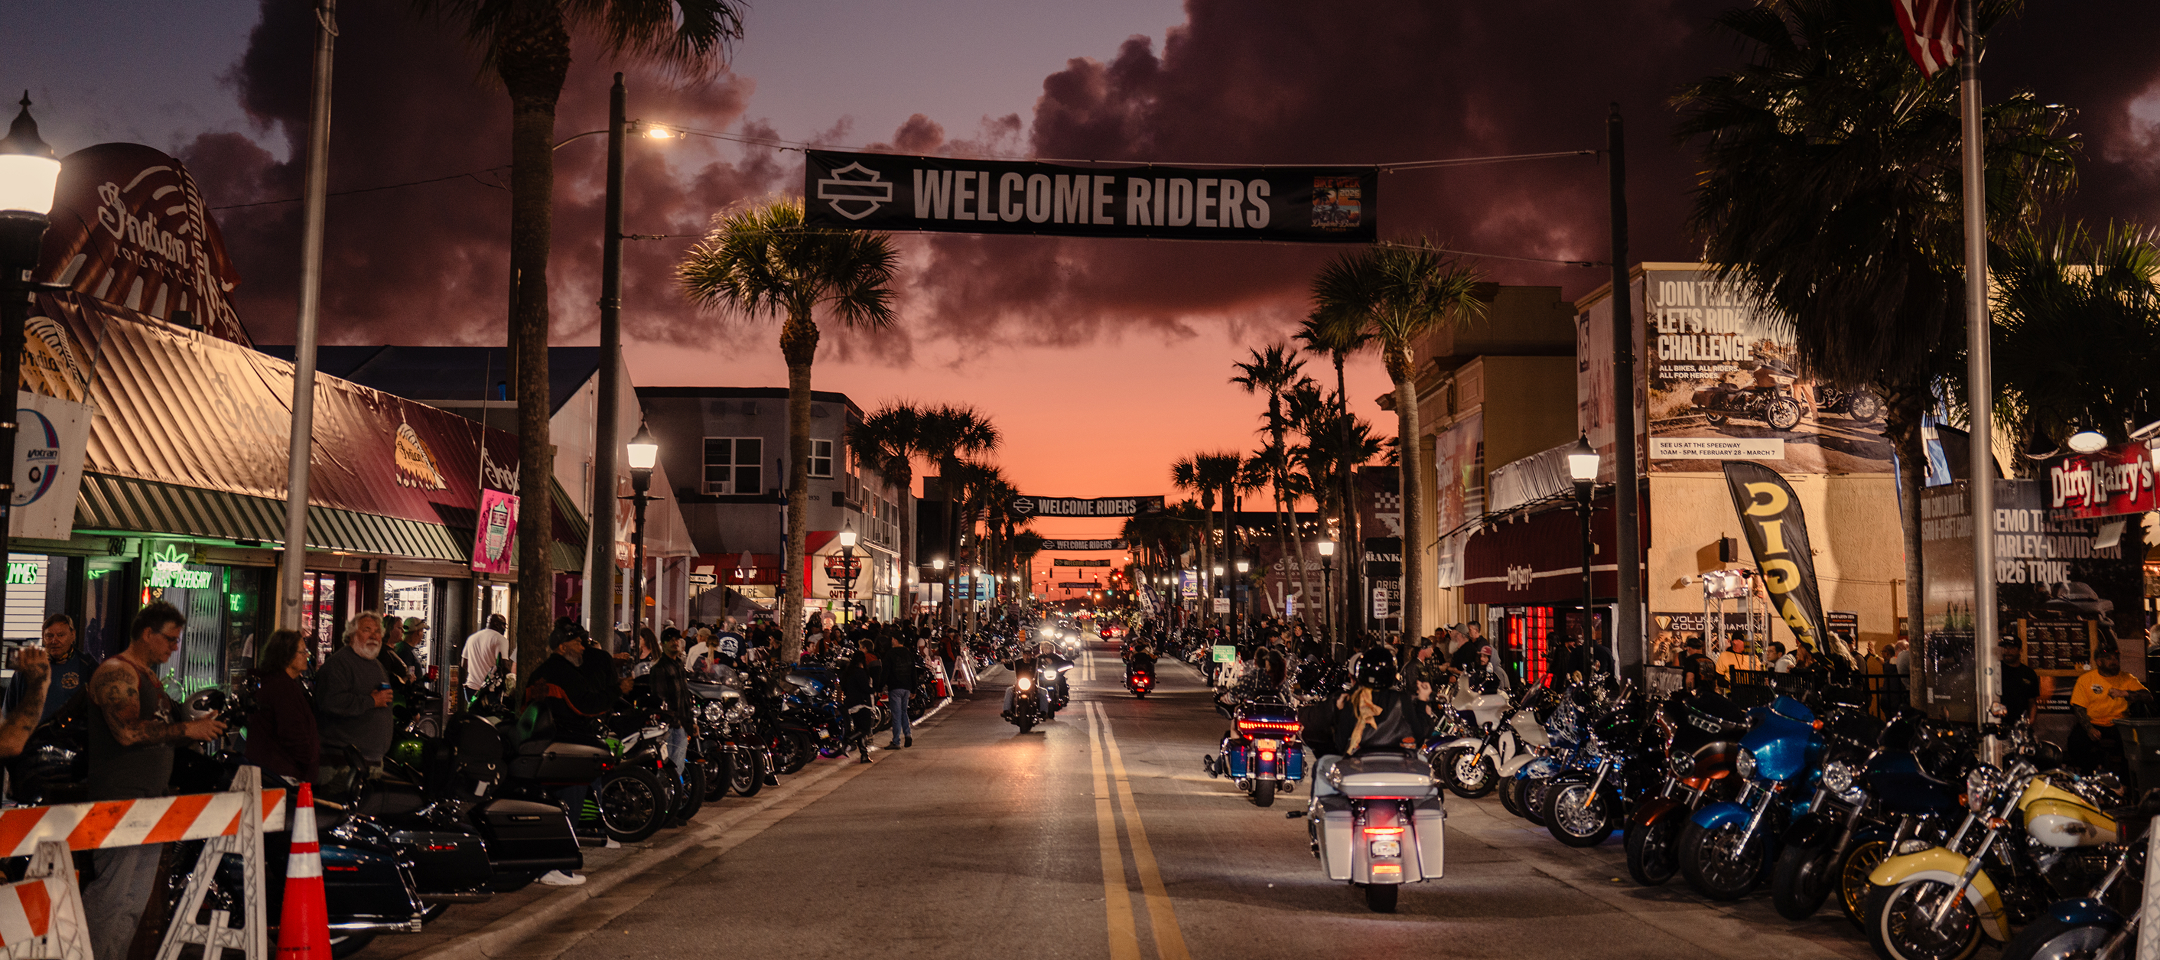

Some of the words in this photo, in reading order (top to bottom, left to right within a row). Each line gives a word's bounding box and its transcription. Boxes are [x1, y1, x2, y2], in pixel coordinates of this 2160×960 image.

[1314, 179, 1334, 188] BIKE
[1336, 180, 1361, 188] WEEK
[913, 169, 1115, 225] WELCOME
[1126, 177, 1270, 230] RIDERS
[1657, 281, 1696, 307] JOIN
[1657, 308, 1703, 334] LET'S
[1706, 308, 1745, 334] RIDE
[1658, 335, 1754, 361] CHALLENGE
[1674, 365, 1697, 373] BIKES,
[27, 449, 58, 458] Votran
[2050, 457, 2092, 508] Dirty
[2092, 454, 2152, 503] Harry's
[1038, 498, 1095, 516] WELCOME
[1096, 499, 1137, 515] RIDERS
[1057, 541, 1088, 550] WELCOME
[1089, 540, 1113, 549] RIDERS
[1366, 552, 1400, 562] BANK
[1996, 561, 2026, 584] 026
[2028, 561, 2072, 584] TRIKE
[1671, 623, 1704, 631] GOLD
